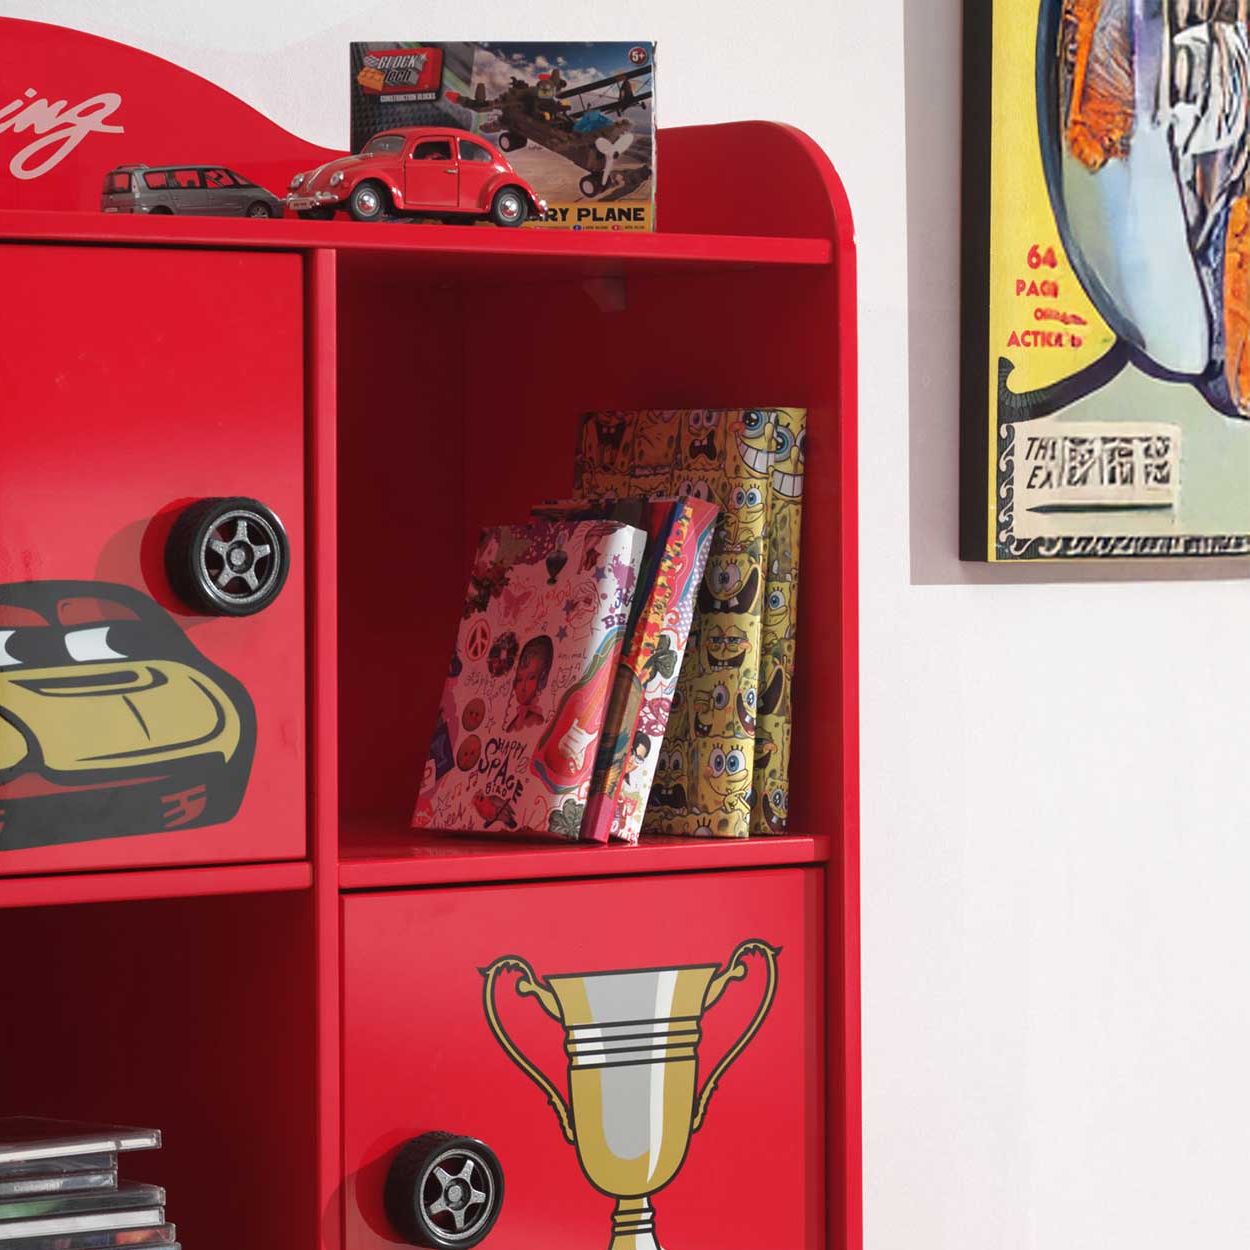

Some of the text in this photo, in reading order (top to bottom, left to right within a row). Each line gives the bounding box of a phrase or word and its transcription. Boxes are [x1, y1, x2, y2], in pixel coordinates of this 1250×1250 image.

[377, 54, 416, 69] BLOCK
[631, 51, 645, 62] 5+
[576, 207, 645, 221] PLANE
[1027, 244, 1058, 270] 64
